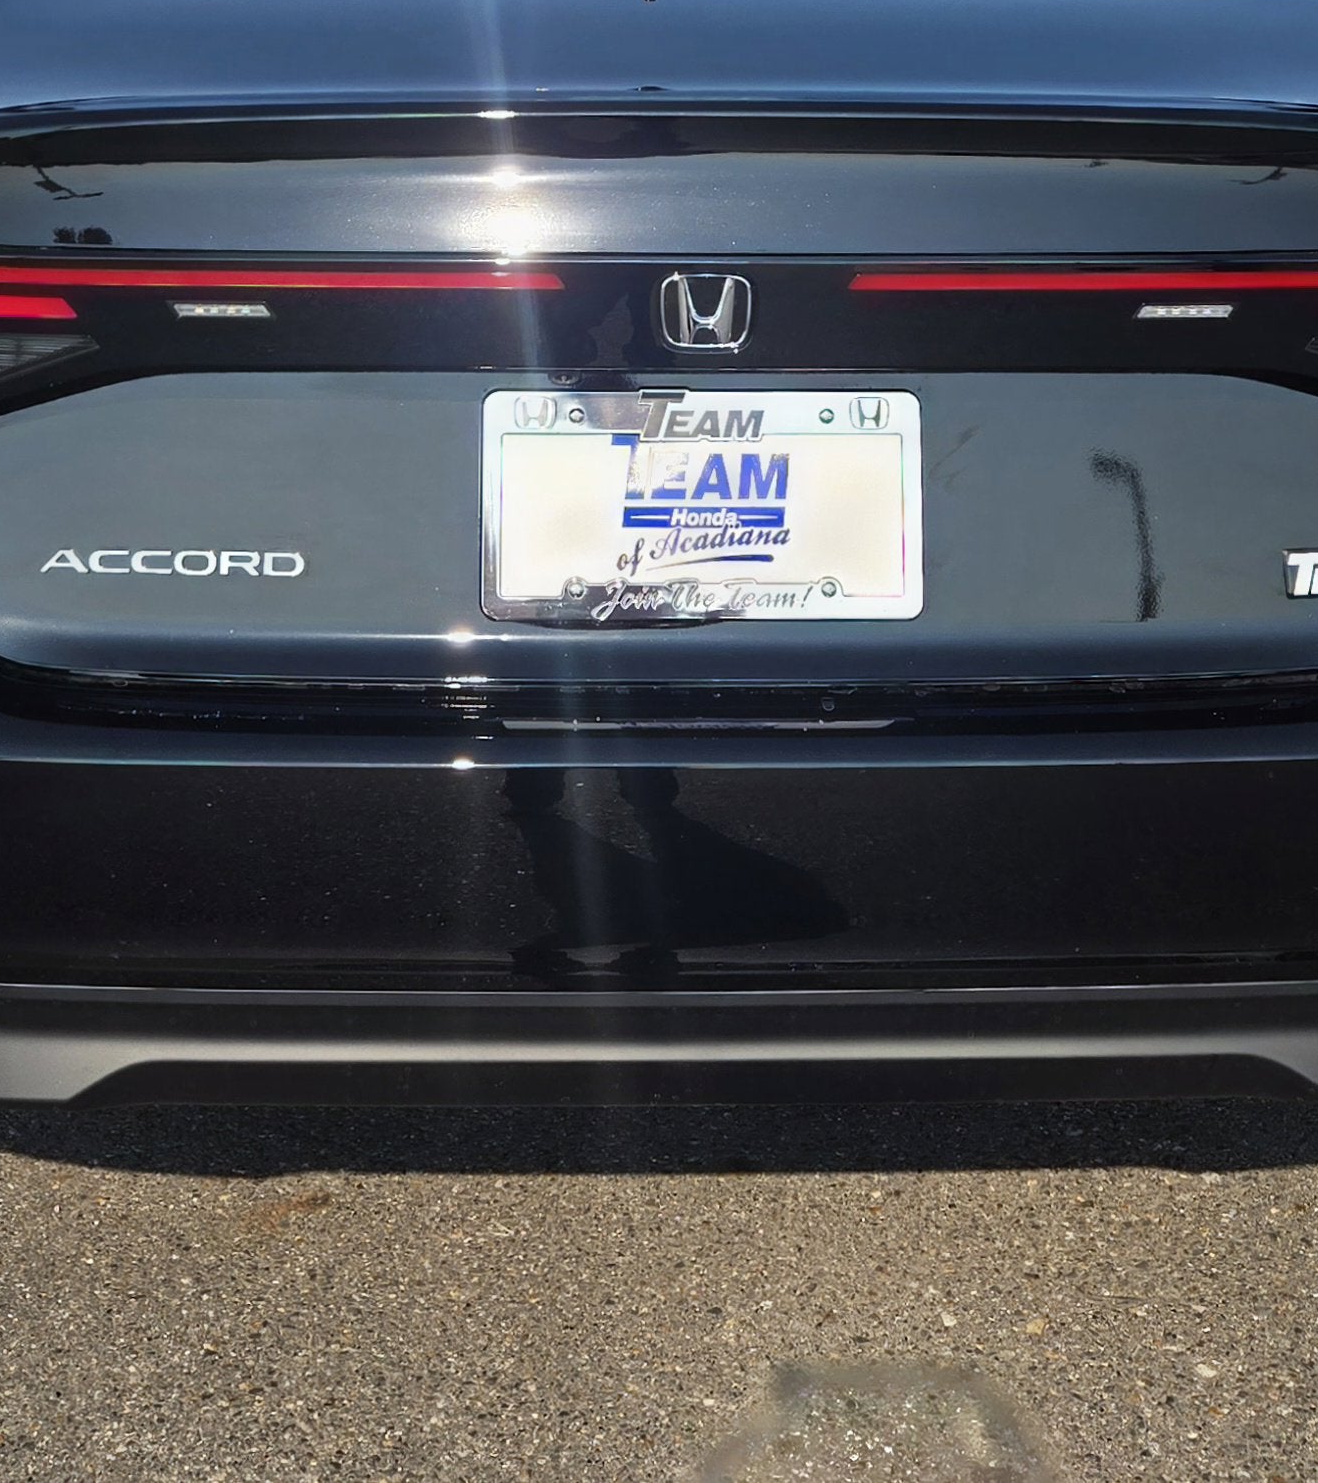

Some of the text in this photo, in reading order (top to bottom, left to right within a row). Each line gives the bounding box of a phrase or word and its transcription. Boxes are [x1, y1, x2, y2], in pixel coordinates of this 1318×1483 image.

[639, 391, 765, 439] TEAM
[611, 434, 789, 500] TEAM
[670, 508, 738, 527] Honda
[39, 549, 305, 577] ACCORD
[616, 522, 791, 577] of Acadiana
[591, 579, 814, 621] Join The Team!
